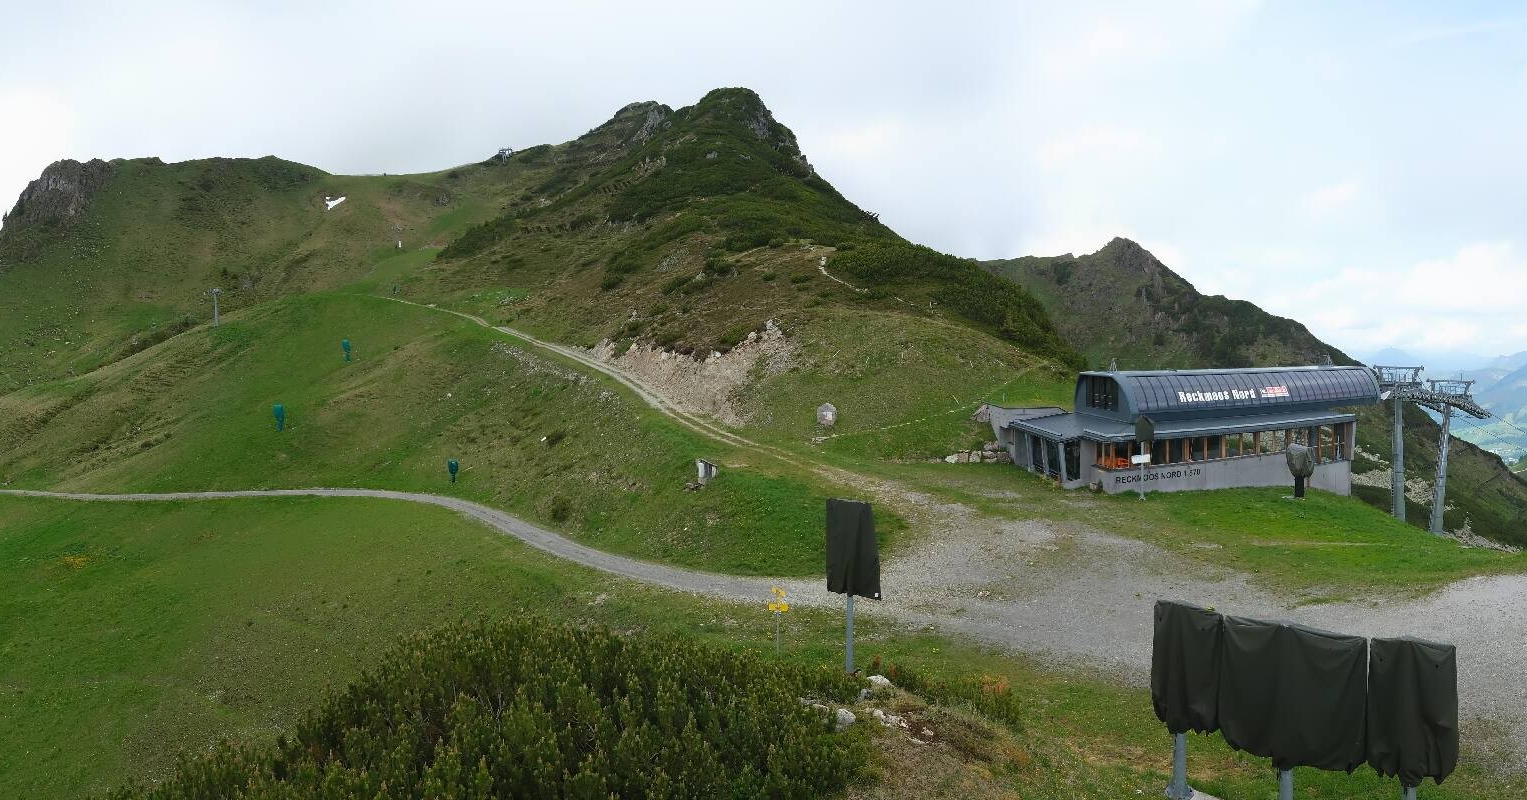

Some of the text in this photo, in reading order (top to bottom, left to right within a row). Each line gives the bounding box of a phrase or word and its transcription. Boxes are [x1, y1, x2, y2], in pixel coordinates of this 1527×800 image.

[1178, 390, 1230, 403] Reckmoos
[1232, 388, 1257, 400] Nord
[1115, 473, 1160, 484] RECKMOOS
[1161, 470, 1182, 479] NORD
